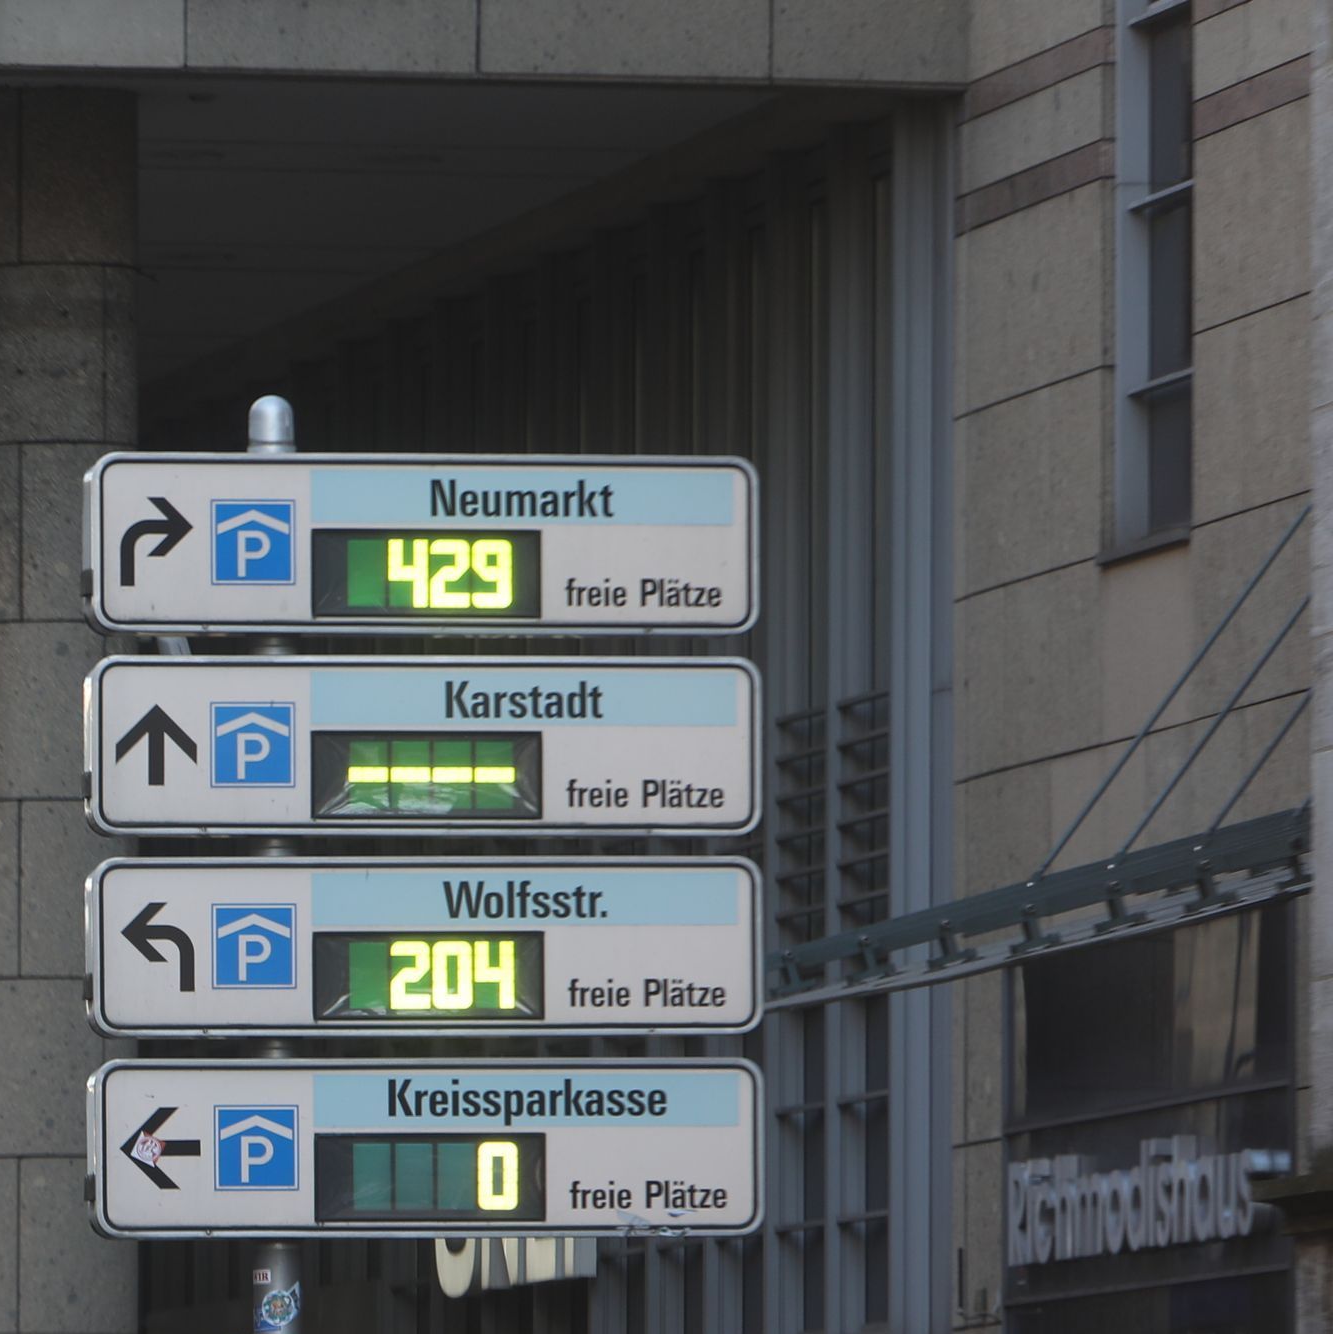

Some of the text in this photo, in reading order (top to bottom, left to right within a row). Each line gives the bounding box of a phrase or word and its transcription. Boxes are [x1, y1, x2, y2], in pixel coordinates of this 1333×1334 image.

[430, 479, 615, 519] Neumarkt
[237, 530, 271, 578] P
[386, 537, 514, 610] 429
[564, 577, 722, 609] freie Plätze
[444, 680, 604, 720] Karstadt
[237, 733, 271, 781] P
[566, 778, 725, 810] freie Plätze
[442, 879, 608, 920] Wolfsstr.
[237, 933, 272, 982] P
[388, 939, 517, 1011] 204
[567, 977, 727, 1009] freie Plätze
[387, 1078, 668, 1123] Kreissparkasse
[240, 1135, 275, 1183] P
[476, 1140, 519, 1212] 0
[568, 1179, 728, 1211] freie Plätze
